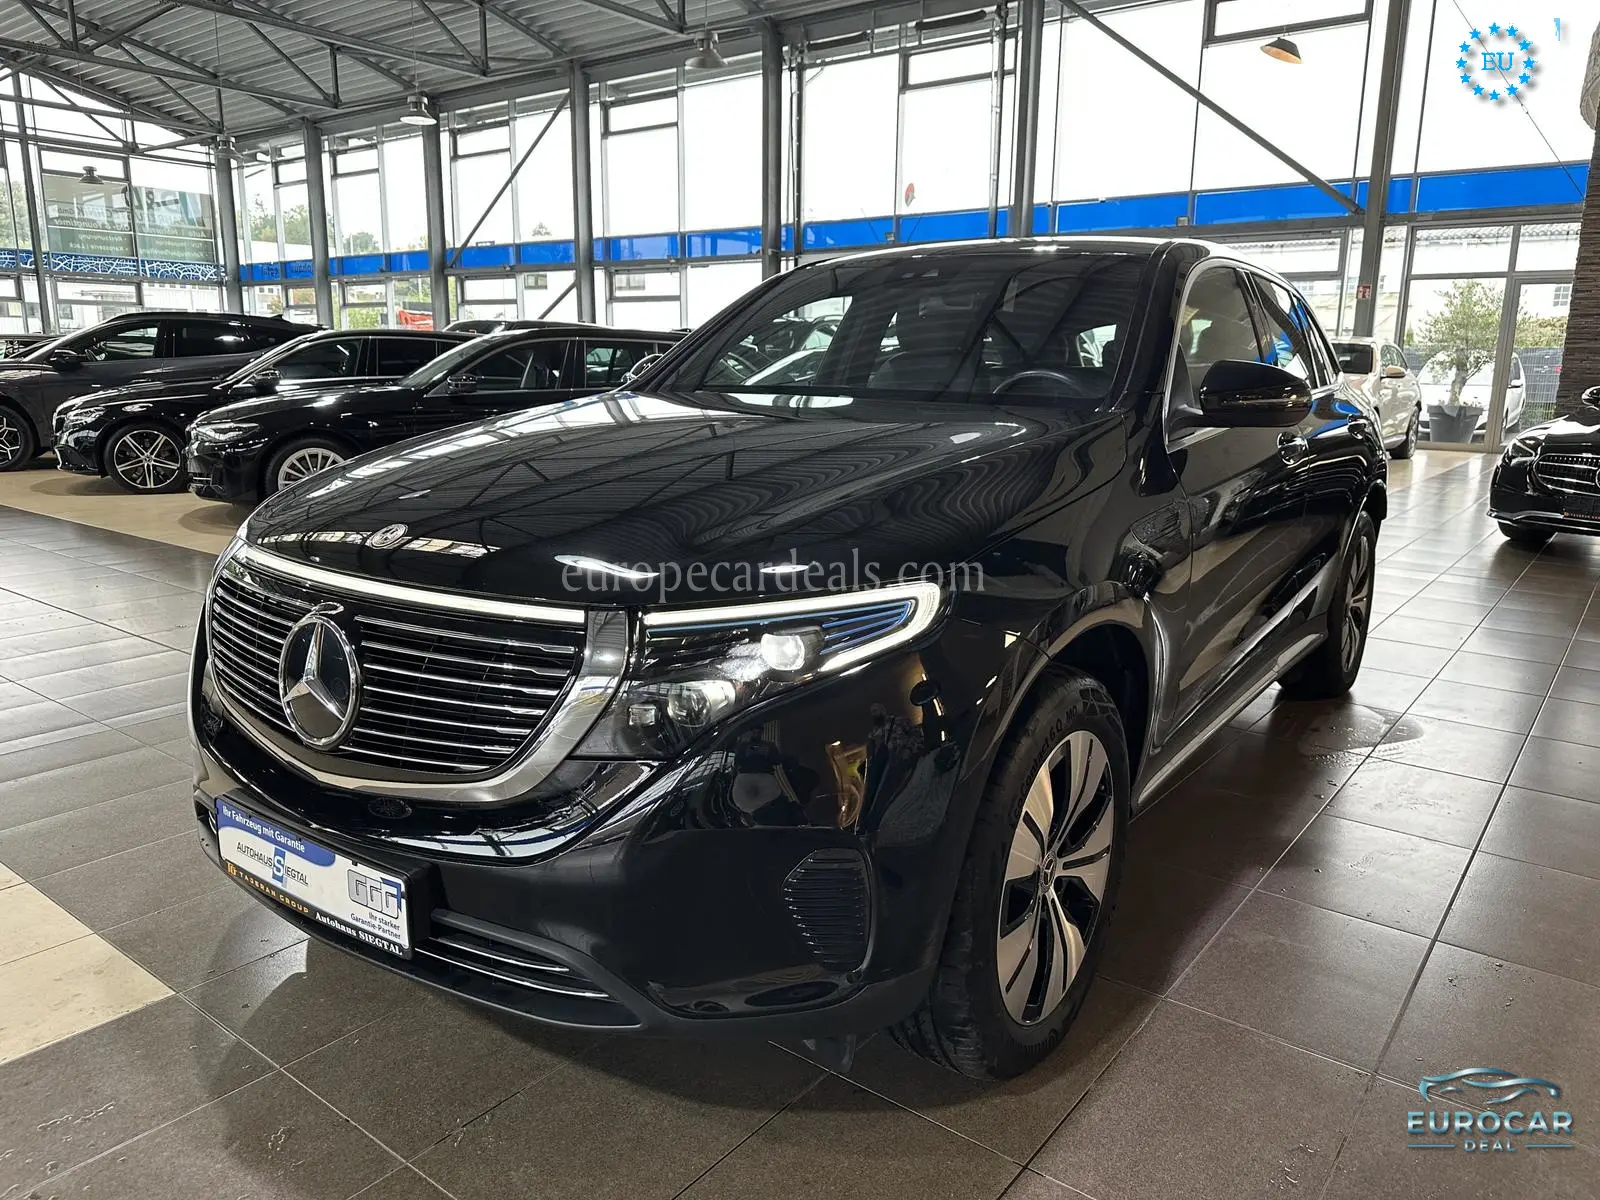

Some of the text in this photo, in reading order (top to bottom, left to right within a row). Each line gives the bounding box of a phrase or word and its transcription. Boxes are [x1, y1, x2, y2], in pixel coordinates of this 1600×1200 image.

[223, 805, 305, 852] Ihr Fahrzeug mit Garantie
[236, 842, 273, 867] AUTOHAUS
[279, 894, 309, 913] GROUP
[315, 912, 403, 955] Autohaus SIEGTAL
[350, 913, 400, 939] Garantie-Partner
[368, 912, 400, 930] Ihr starker
